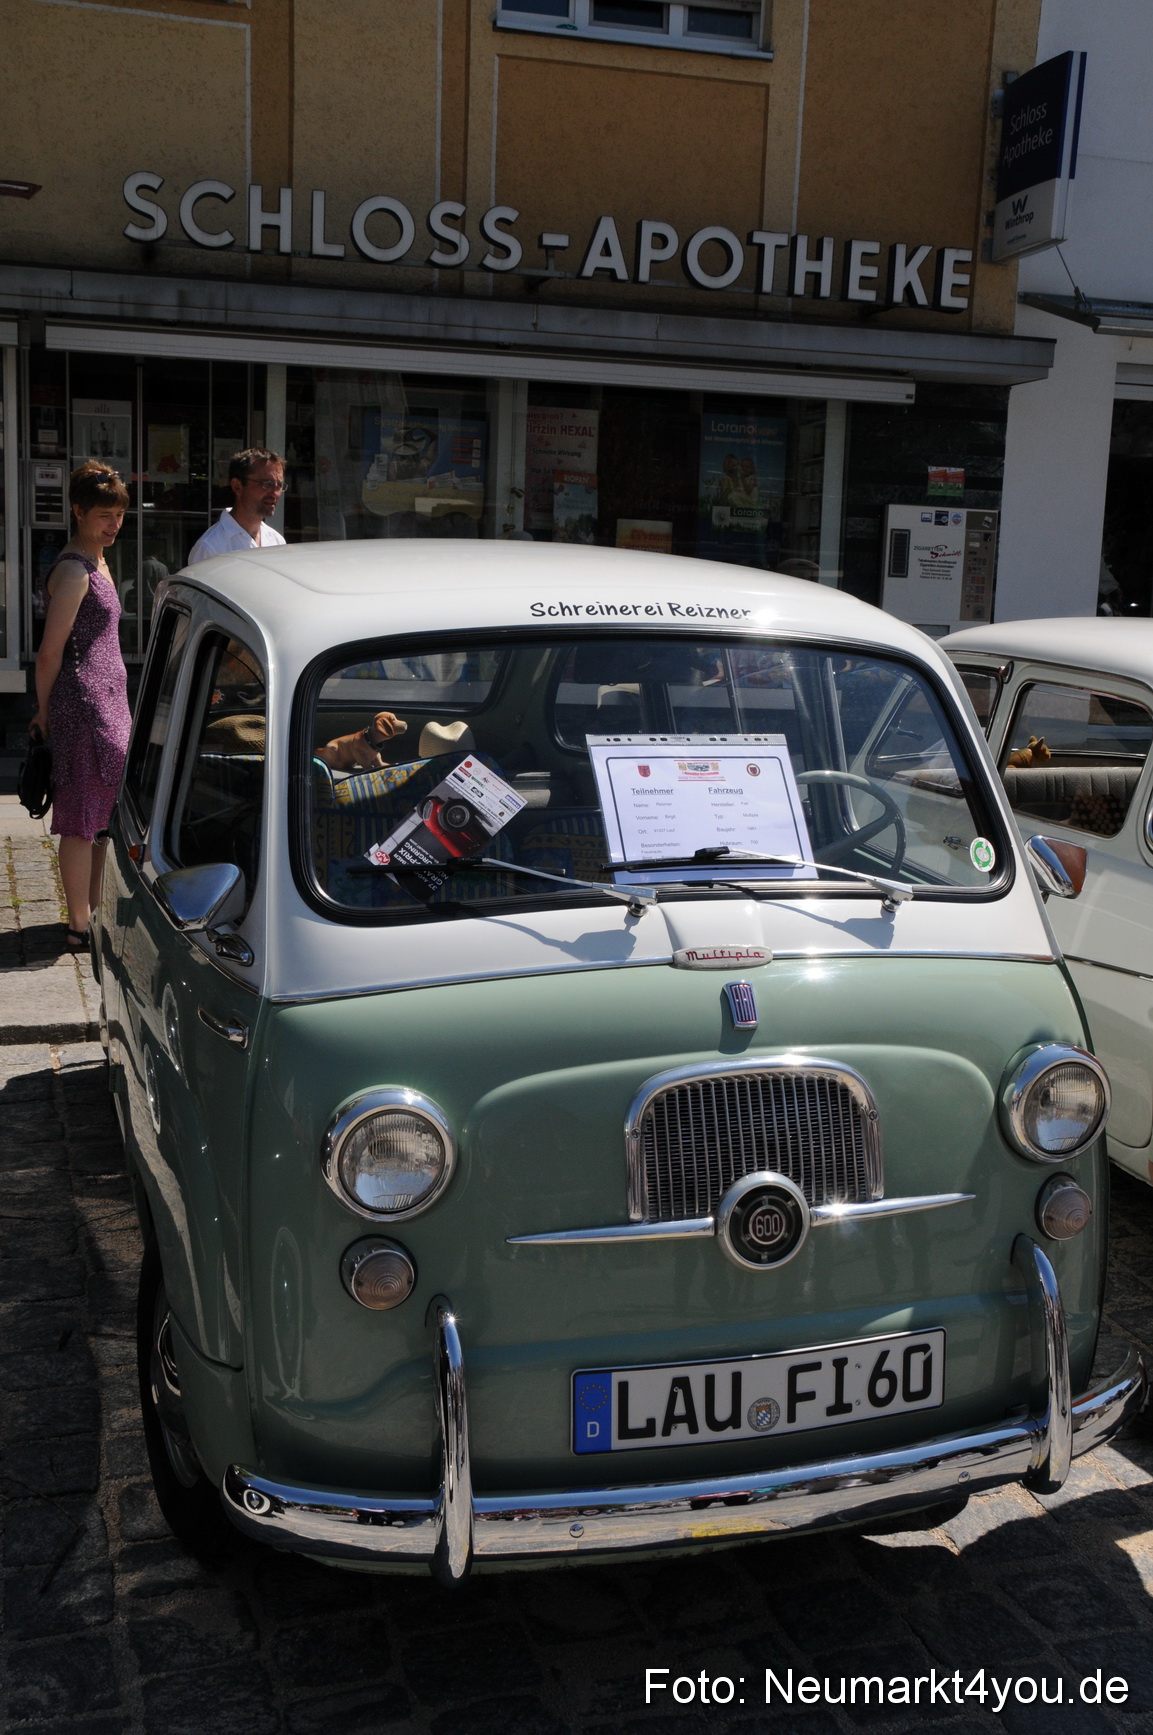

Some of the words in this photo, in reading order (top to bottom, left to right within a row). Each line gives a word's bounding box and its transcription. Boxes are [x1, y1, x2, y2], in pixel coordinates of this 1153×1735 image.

[1010, 102, 1048, 136] Schloss
[1002, 127, 1054, 168] Apotheke
[1005, 210, 1034, 231] Winthrop
[122, 171, 973, 310] SCHLOSS-APOTHEKE
[560, 425, 594, 437] HEXAL
[711, 420, 754, 434] Lorano
[733, 508, 764, 517] Lorano
[530, 602, 664, 618] Schreinerei
[668, 602, 752, 620] Reizner
[708, 787, 744, 795] Fahrzeug
[686, 948, 764, 961] Multipla
[732, 984, 756, 1022] FIAT
[756, 1214, 780, 1238] 600
[617, 1372, 742, 1440] LAU
[786, 1357, 853, 1424] FI
[868, 1343, 932, 1408] 60
[586, 1421, 600, 1438] D
